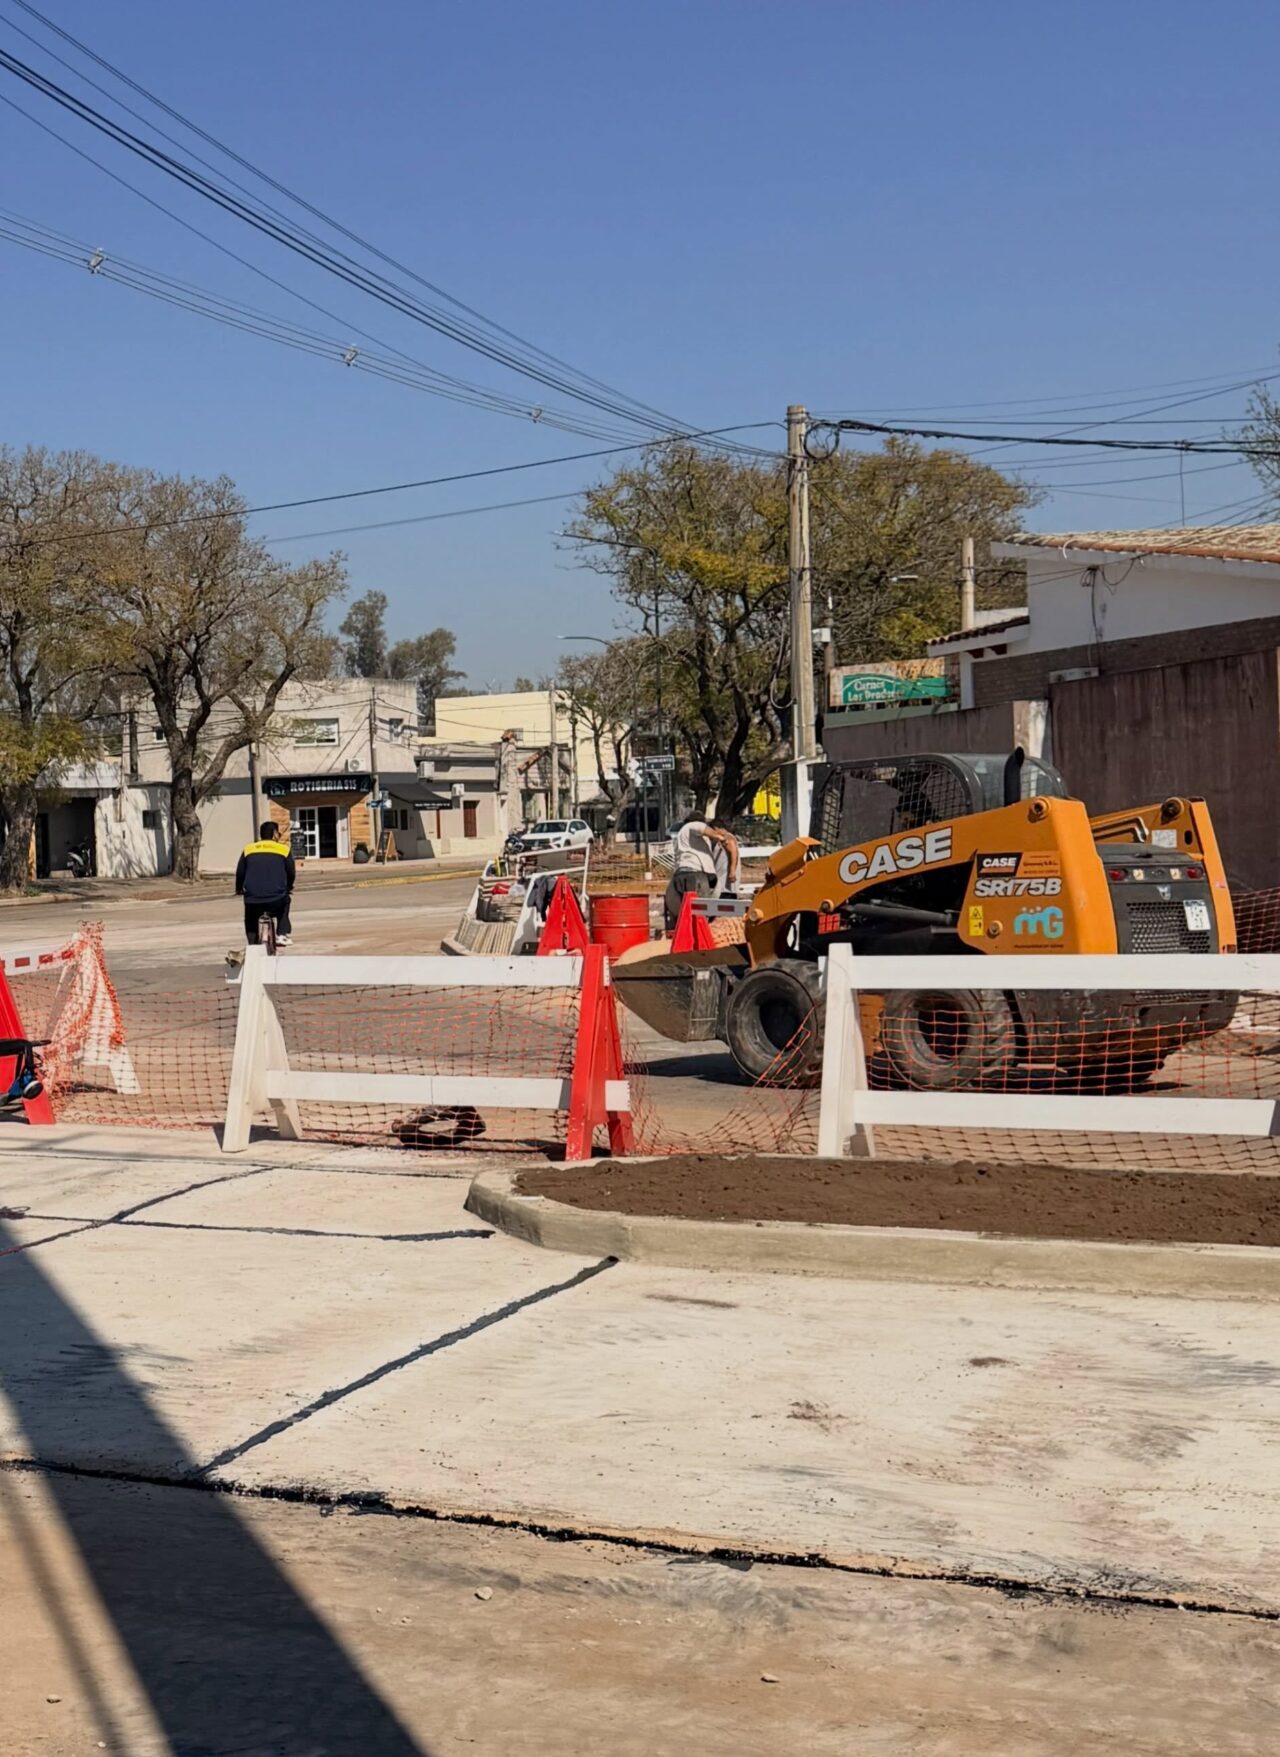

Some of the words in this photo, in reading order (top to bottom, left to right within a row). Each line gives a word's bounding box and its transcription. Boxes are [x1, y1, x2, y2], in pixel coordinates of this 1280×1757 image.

[838, 826, 953, 885] CASE
[982, 857, 1018, 868] CASE
[974, 877, 1063, 898] SR175B
